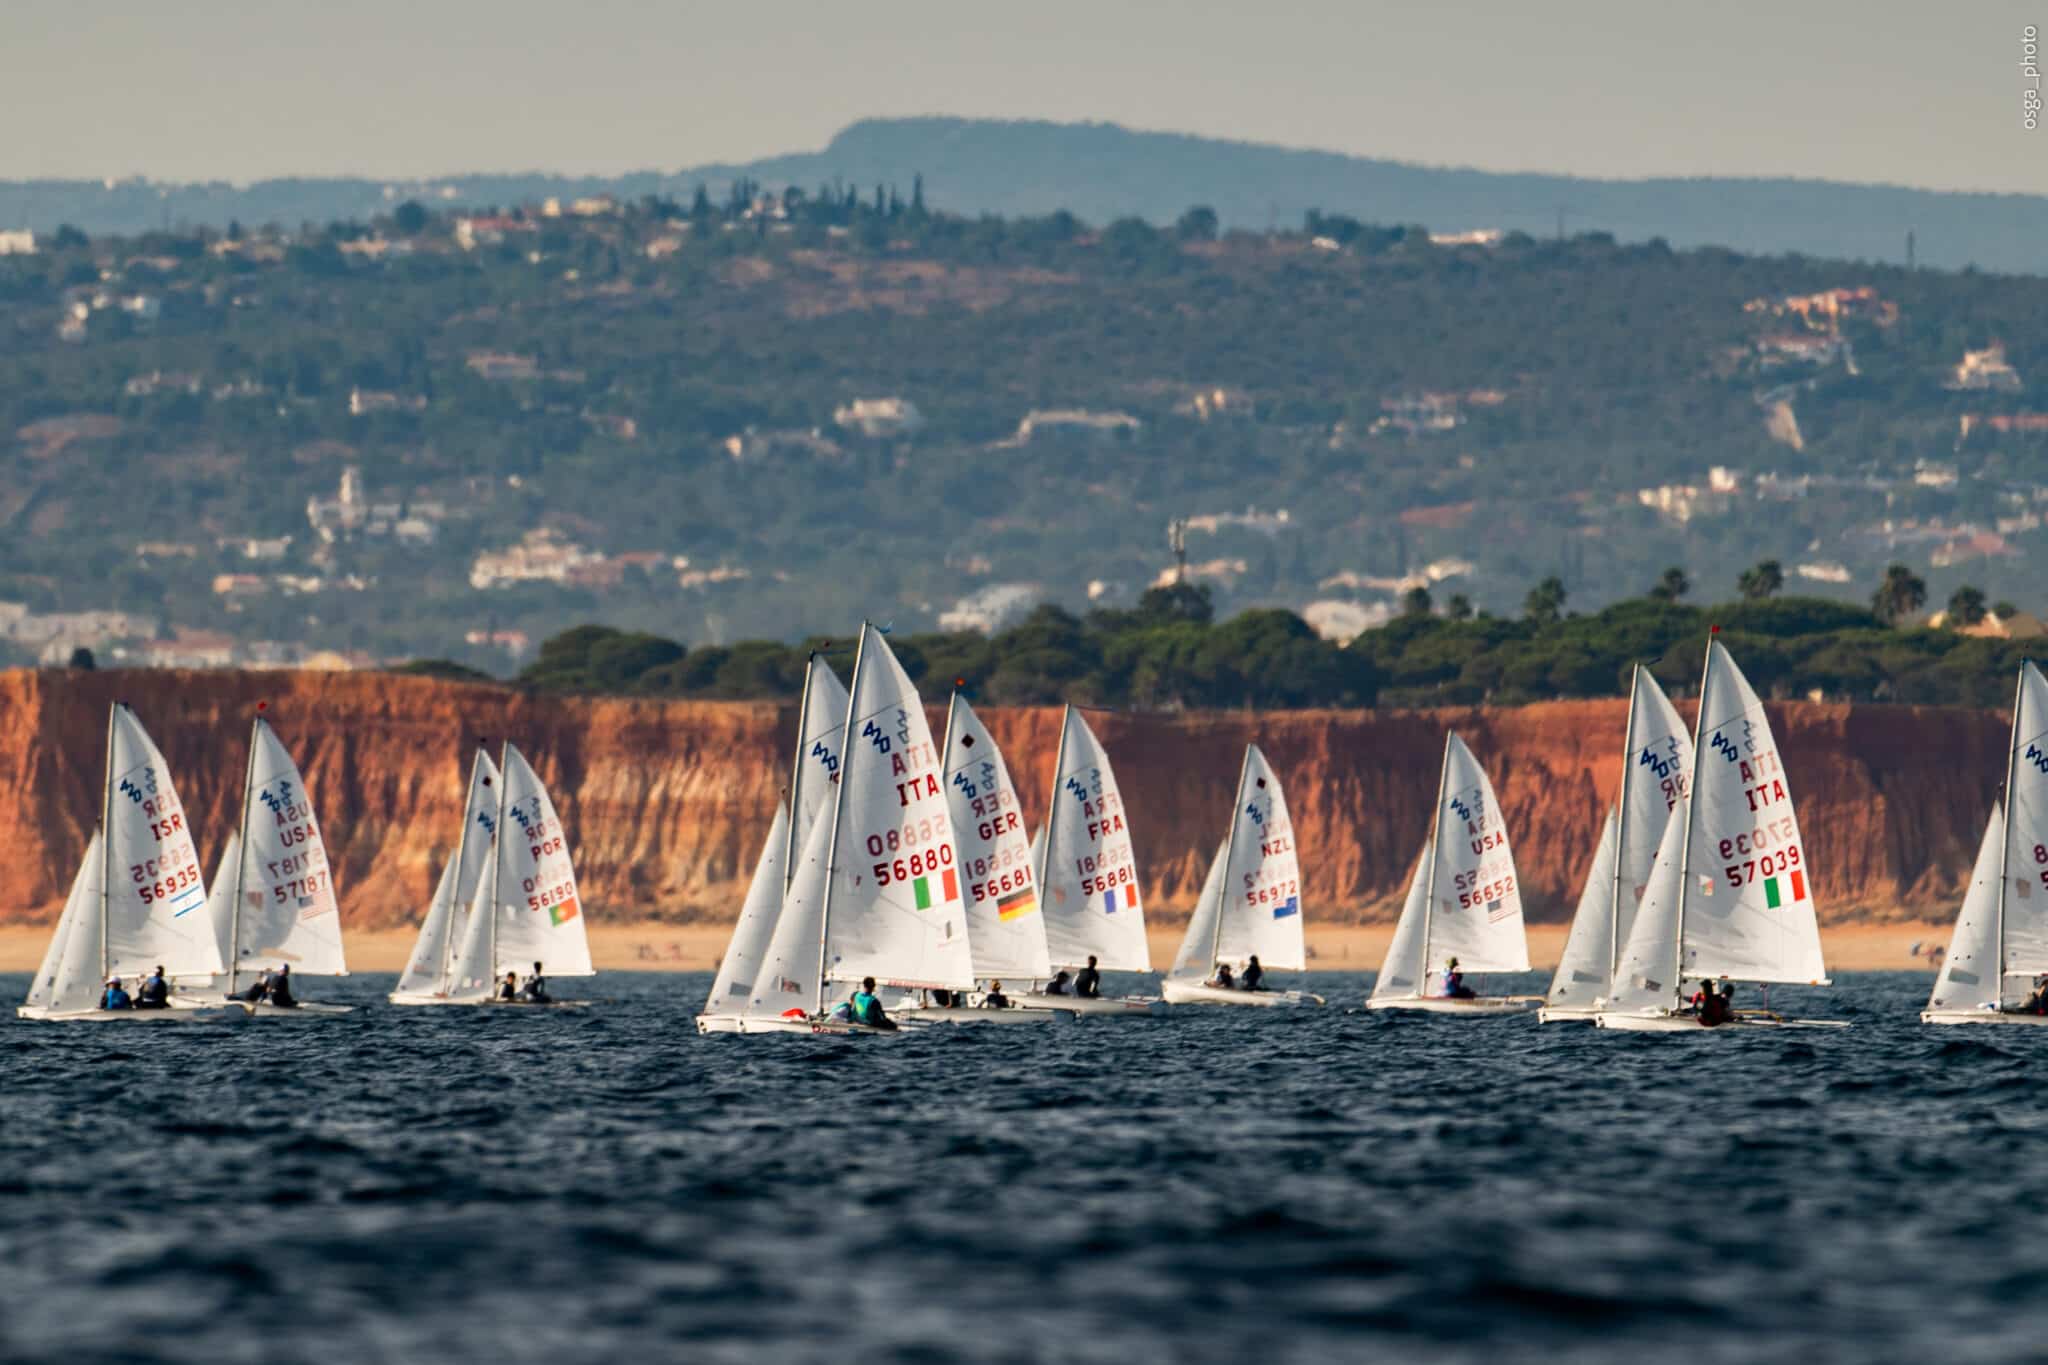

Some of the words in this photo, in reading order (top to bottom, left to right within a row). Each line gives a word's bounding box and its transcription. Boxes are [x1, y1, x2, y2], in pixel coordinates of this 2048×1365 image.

[862, 720, 890, 754] 420
[1712, 731, 1738, 762] 420
[812, 741, 837, 772] 420
[1640, 749, 1668, 778] 420
[120, 778, 141, 803] 420
[896, 774, 940, 806] ITA
[953, 771, 976, 799] 420
[1066, 777, 1088, 802] 420
[1745, 782, 1785, 812] ITA
[151, 814, 183, 841] ISR
[281, 823, 316, 848] USA
[979, 812, 1019, 840] GER
[1088, 816, 1123, 841] FRA
[531, 837, 562, 862] POR
[1261, 840, 1291, 858] NZL
[1472, 832, 1504, 855] USA
[873, 844, 952, 886] 56880
[1082, 864, 1133, 895] 56881
[1725, 845, 1799, 887] 57039
[139, 864, 199, 904] 56935
[274, 871, 328, 904] 57187
[528, 881, 573, 911] 56190
[971, 865, 1031, 902] 56681
[1459, 876, 1514, 909] 56652
